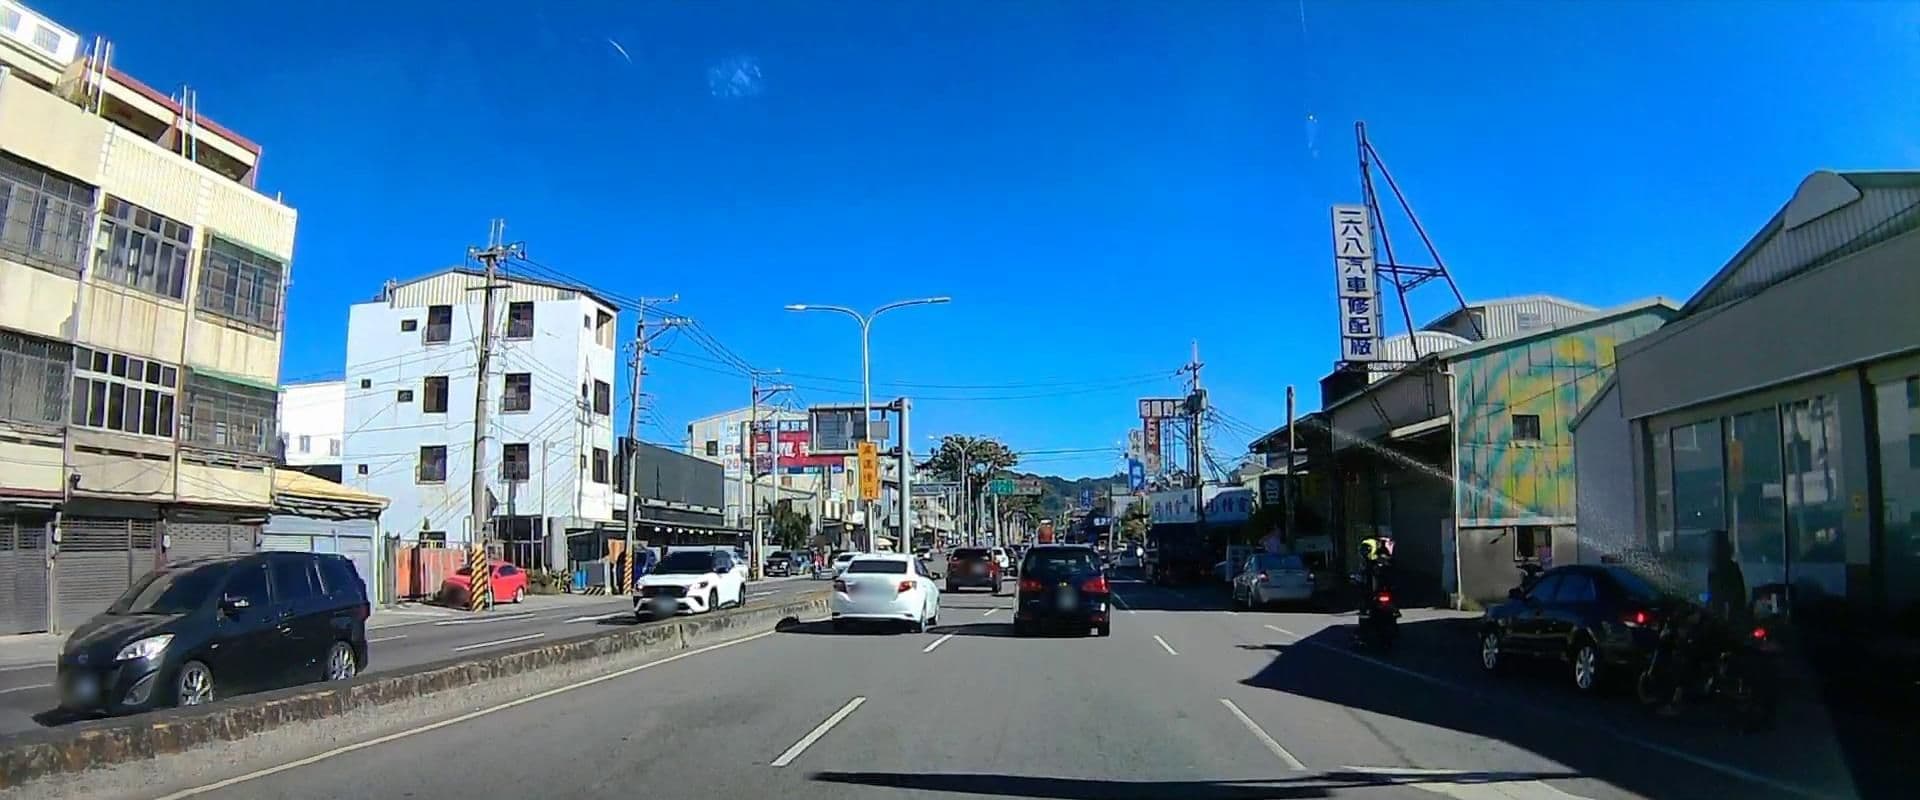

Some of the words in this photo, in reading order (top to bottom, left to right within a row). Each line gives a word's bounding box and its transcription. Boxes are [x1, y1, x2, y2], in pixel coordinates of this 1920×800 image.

[1339, 210, 1372, 356] 一六八汽車修配廠
